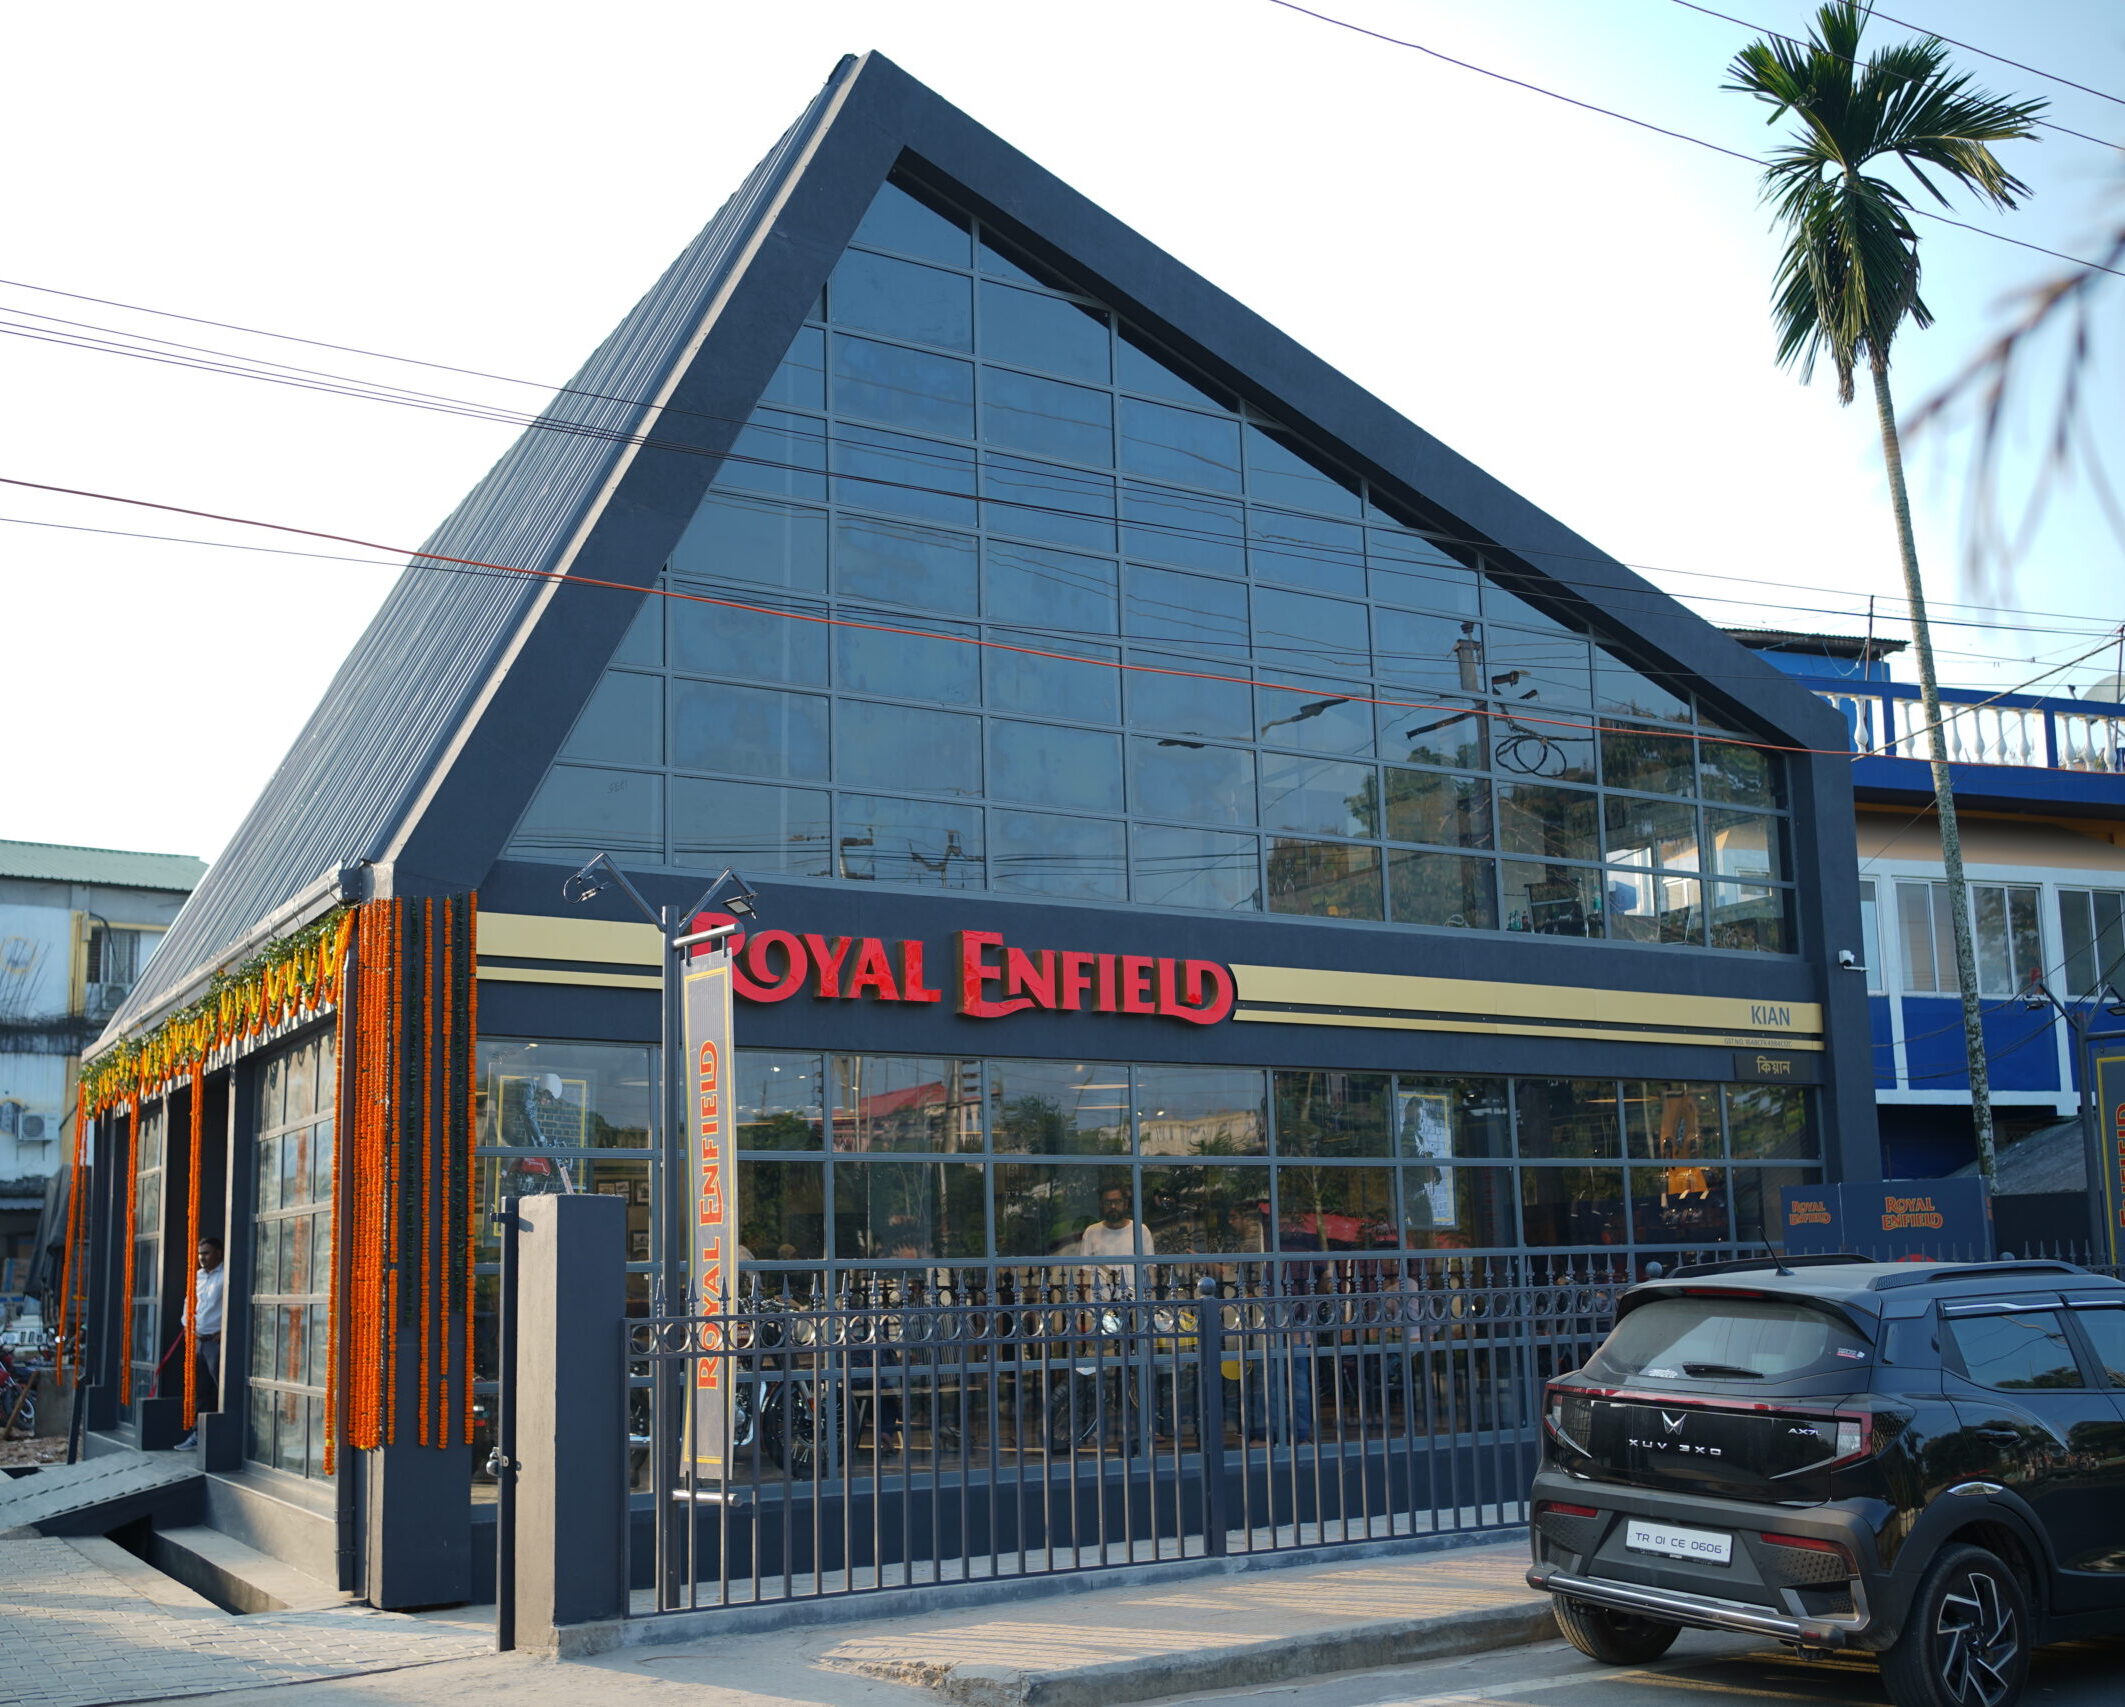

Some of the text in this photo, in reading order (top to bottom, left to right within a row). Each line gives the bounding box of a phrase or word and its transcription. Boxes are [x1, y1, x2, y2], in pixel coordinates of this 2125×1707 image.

[689, 911, 1234, 1025] ROYAL ENFIELD
[1750, 1005, 1791, 1026] KIAN
[1755, 1055, 1792, 1075] কিয়ান
[1791, 1201, 1826, 1213] ROYAL
[1884, 1196, 1936, 1213] ROYAL
[697, 1040, 724, 1390] ROYAL ENFIELD
[1789, 1212, 1832, 1226] ENFIELD
[1881, 1212, 1944, 1231] ENFIELD
[1787, 1427, 1822, 1437] AX7L
[1628, 1438, 1722, 1456] XUV 3XO
[1635, 1532, 1650, 1543] TR
[1671, 1538, 1686, 1548] CE
[1691, 1541, 1722, 1554] 0606
